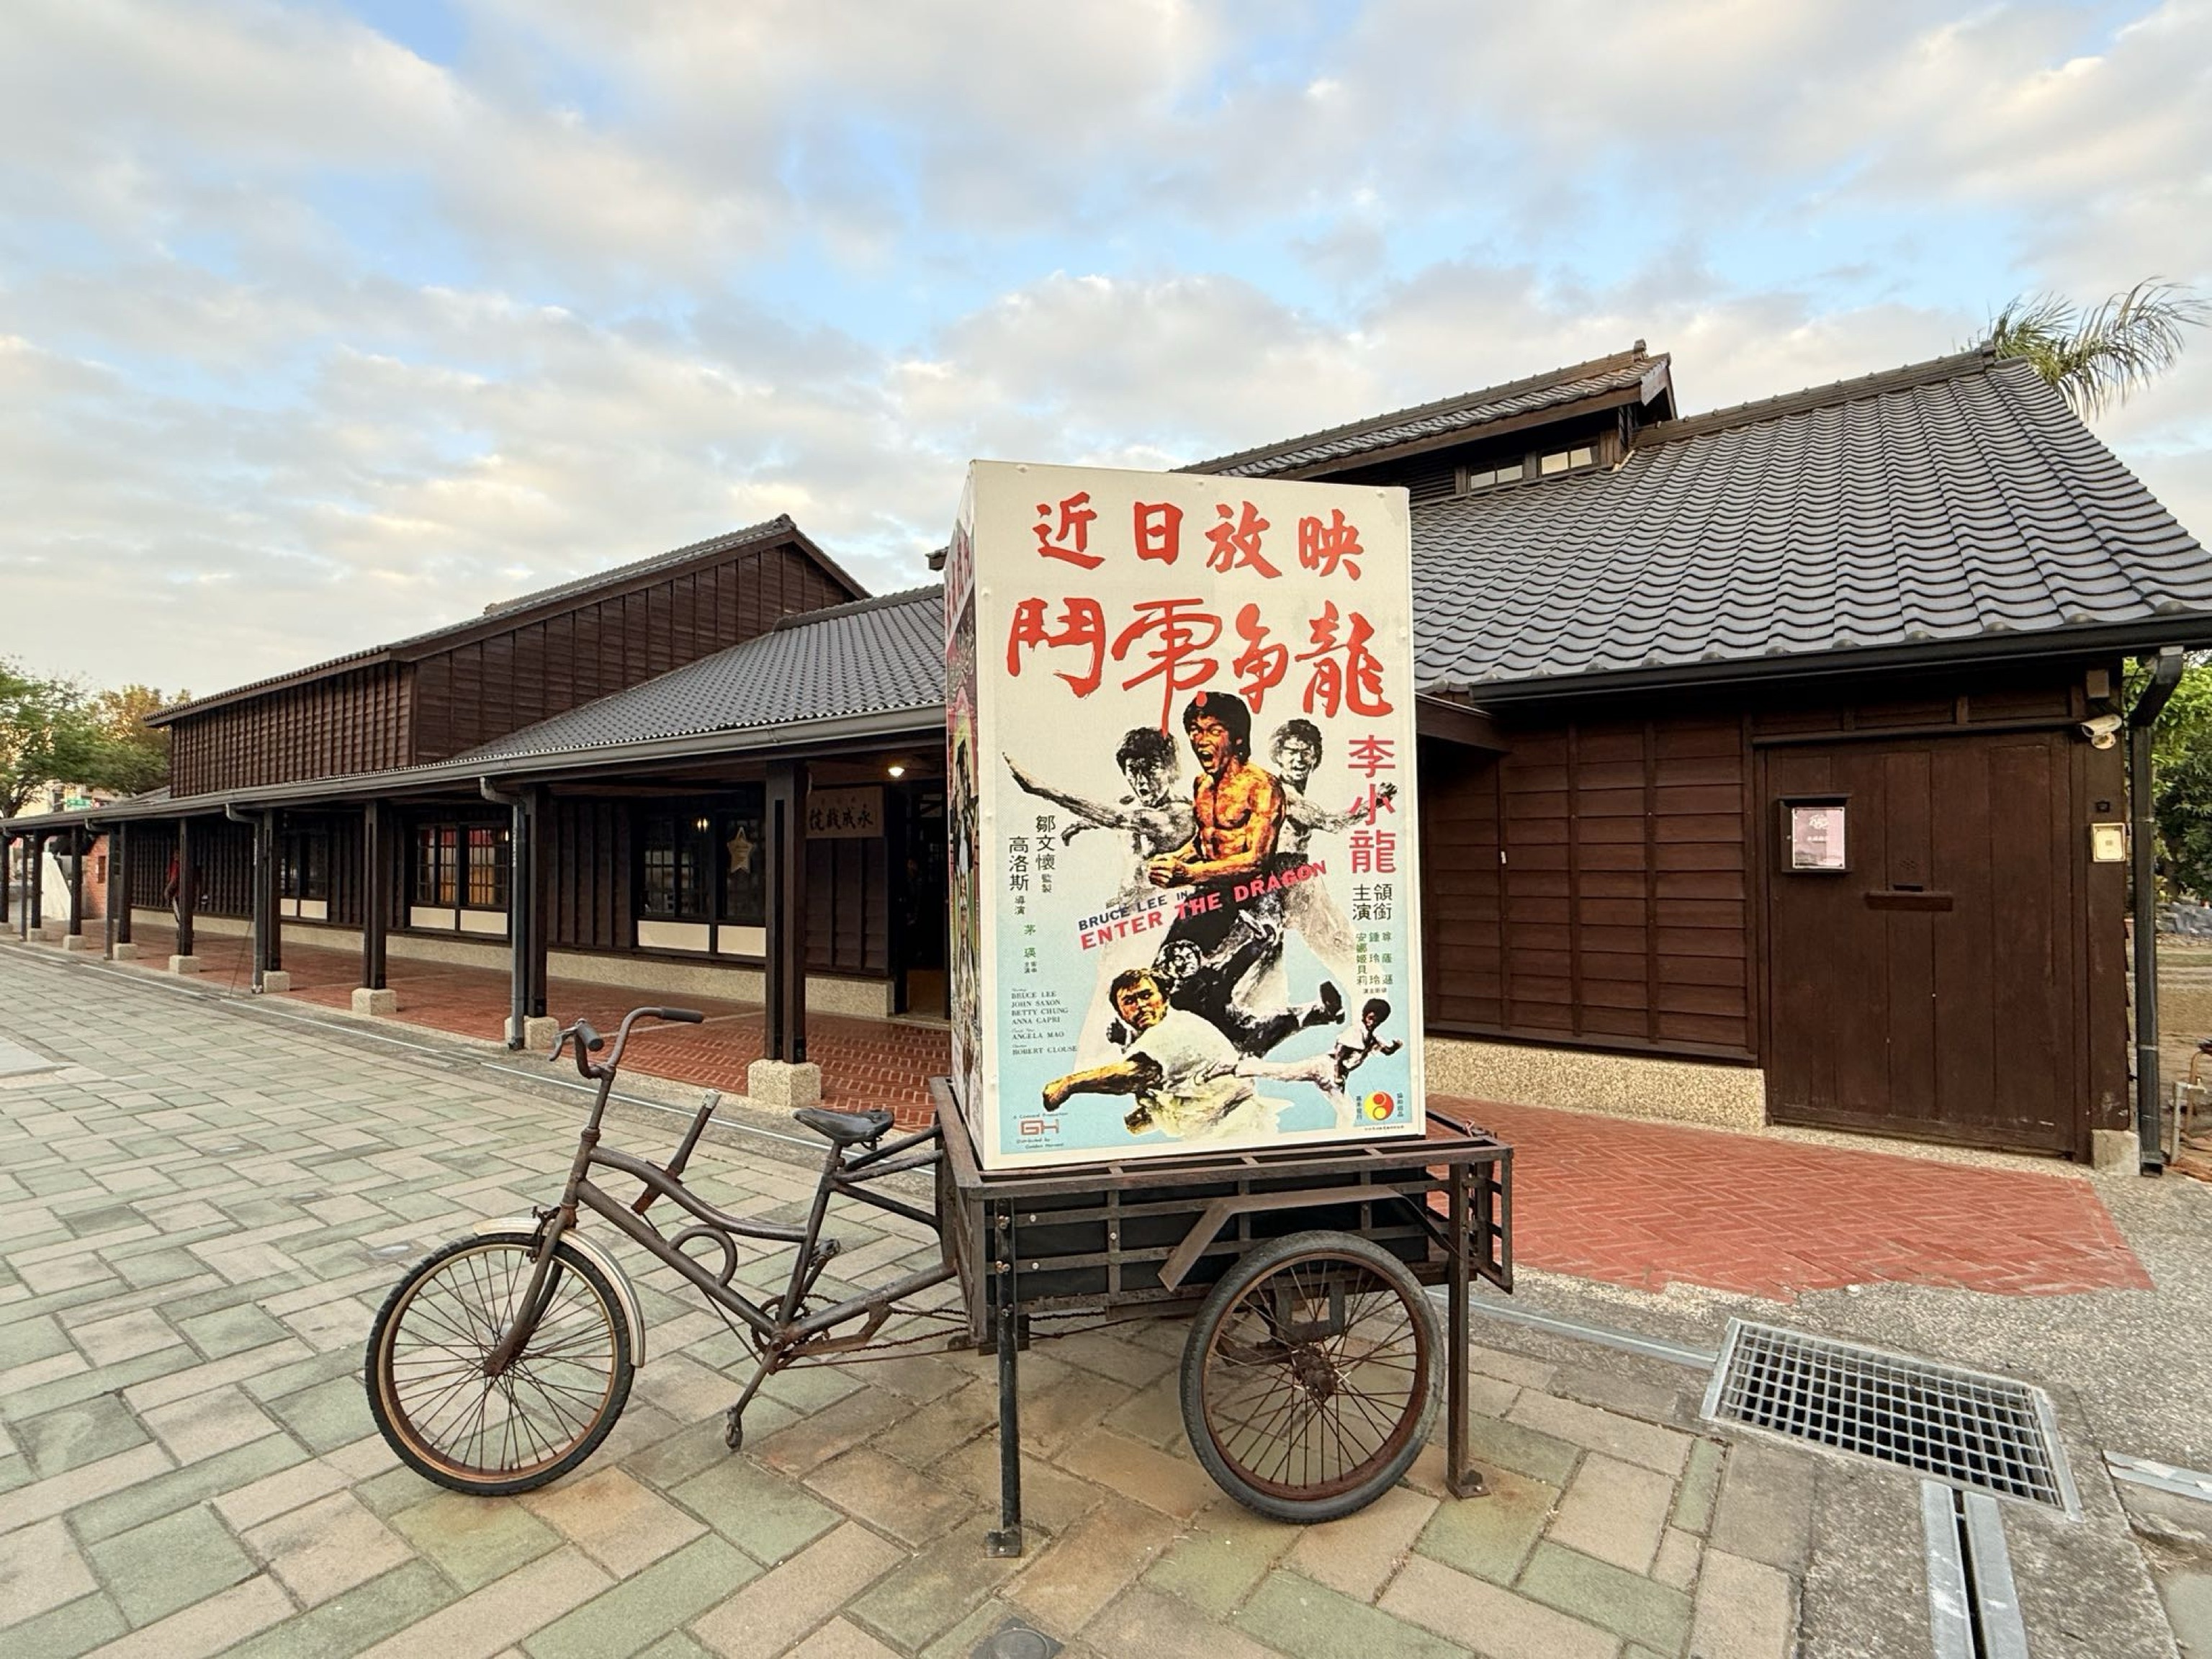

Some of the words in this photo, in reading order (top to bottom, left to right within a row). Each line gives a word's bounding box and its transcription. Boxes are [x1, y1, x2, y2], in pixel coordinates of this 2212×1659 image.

[1032, 490, 1364, 581] 近日放映
[1347, 734, 1396, 874] 李小龍
[1078, 906, 1130, 931] BRUCE
[1137, 894, 1168, 912] LEE
[1176, 890, 1189, 900] IN
[1080, 911, 1164, 950] ENTER
[1174, 892, 1223, 920] THE
[1233, 860, 1327, 902] DRAGON
